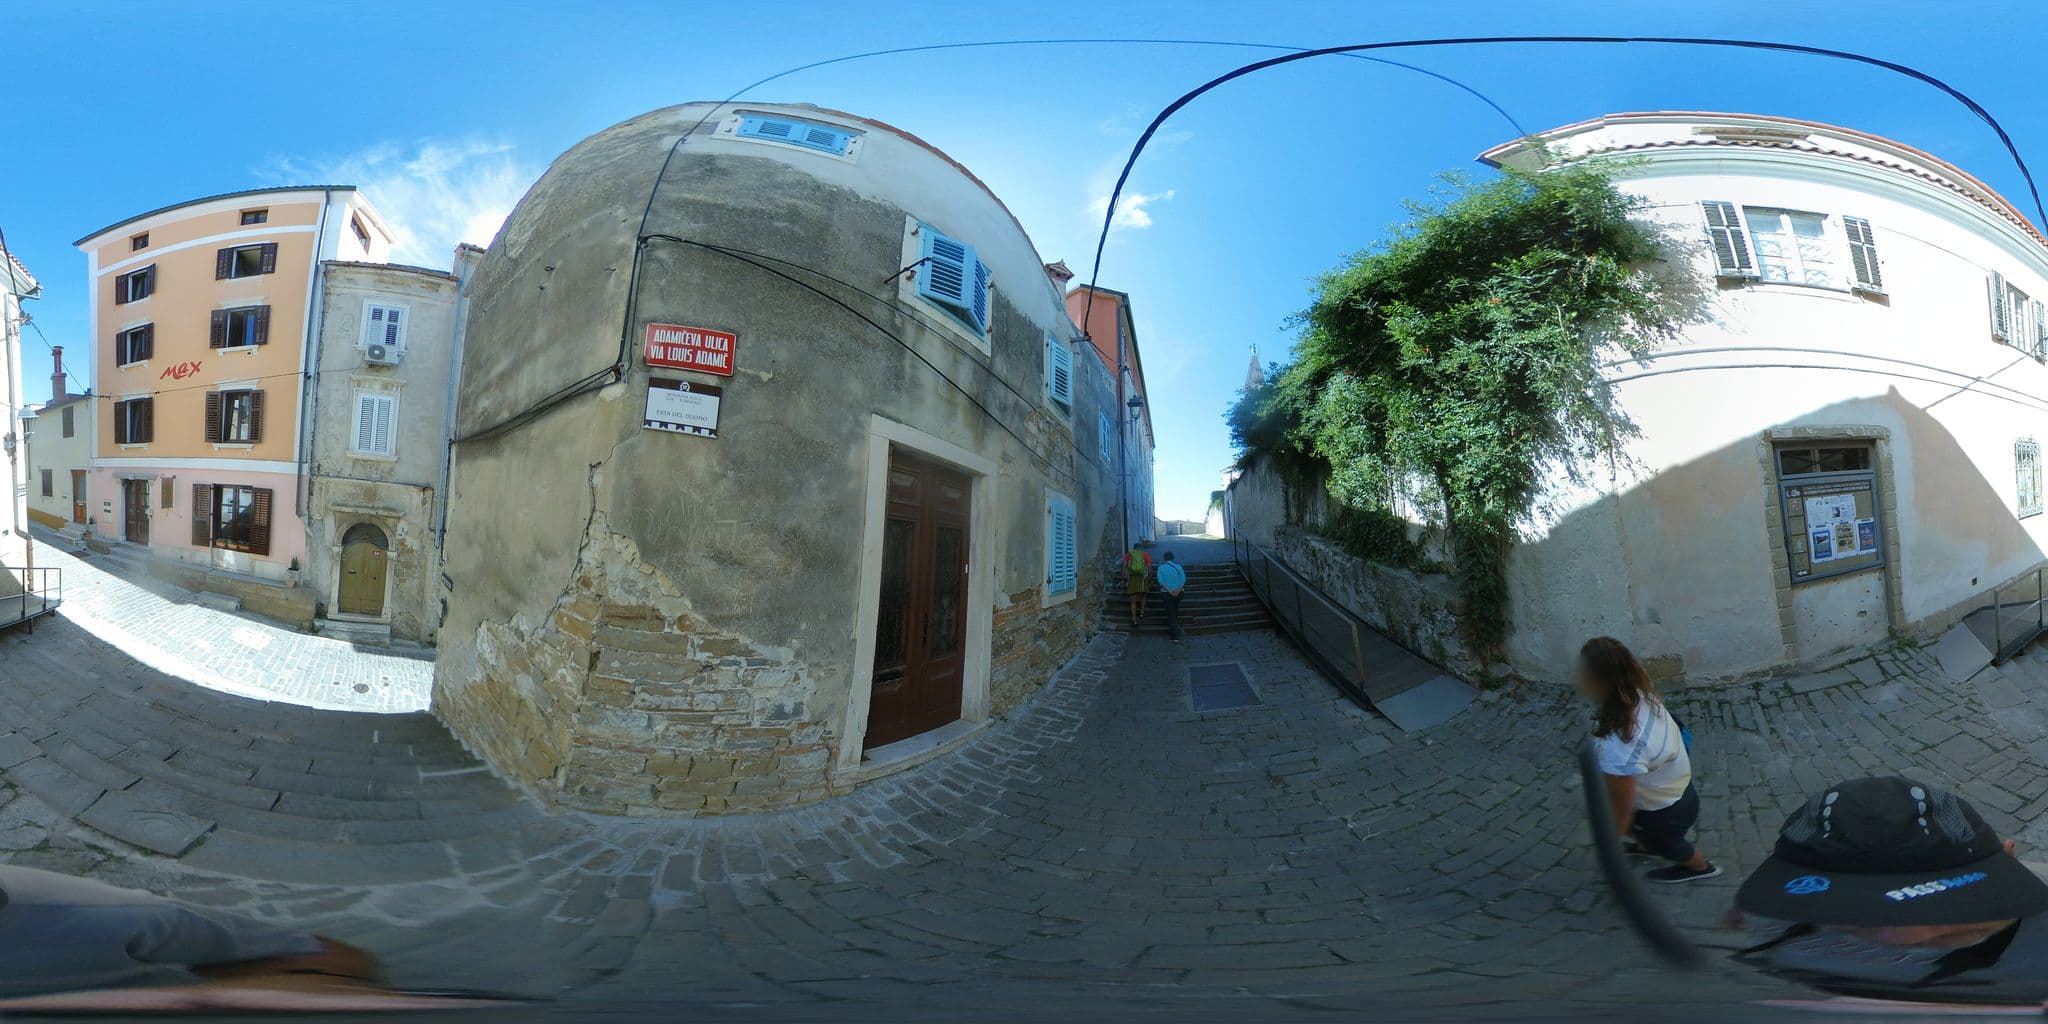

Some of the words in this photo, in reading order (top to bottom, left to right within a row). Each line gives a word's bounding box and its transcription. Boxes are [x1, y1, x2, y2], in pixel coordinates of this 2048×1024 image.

[653, 329, 702, 347] ADAMIČEVA
[704, 335, 729, 352] ULICA
[651, 345, 664, 360] VIA
[667, 346, 693, 363] LOUIS
[695, 350, 729, 368] ADAMIČ
